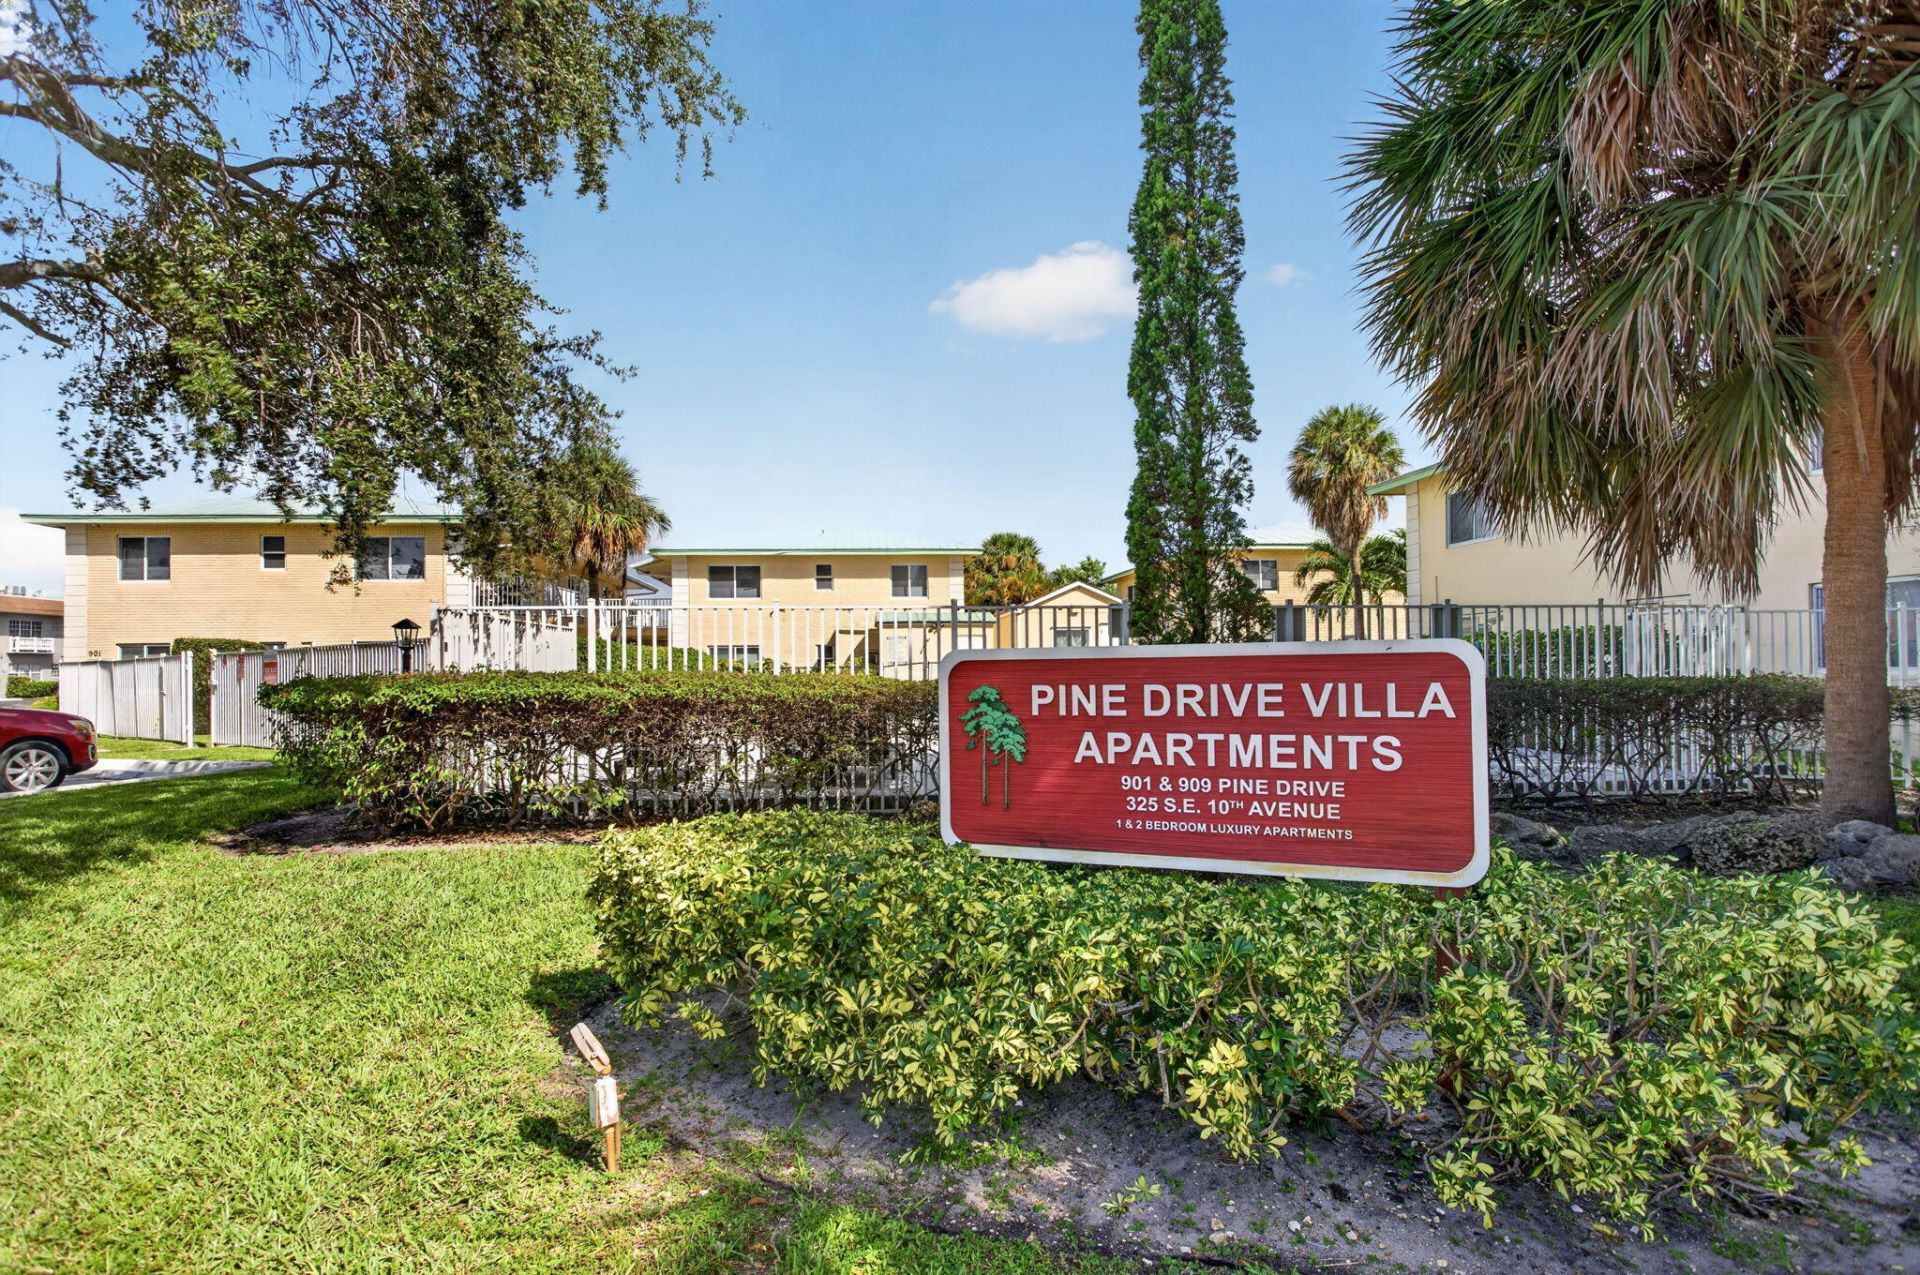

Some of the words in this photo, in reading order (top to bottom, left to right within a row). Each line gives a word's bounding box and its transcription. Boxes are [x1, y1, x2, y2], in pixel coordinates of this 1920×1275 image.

[1031, 684, 1127, 717] PINE
[1143, 683, 1285, 718] DRIVE
[1300, 682, 1457, 718] VILLA
[1074, 731, 1403, 772] APARTMENTS
[1121, 775, 1151, 791] 901
[1159, 776, 1173, 792] &
[1178, 777, 1212, 793] 909
[1218, 778, 1269, 795] PINE
[1276, 779, 1346, 798] DRIVE
[1126, 796, 1159, 812] 325
[1164, 797, 1201, 814] S.E.
[1207, 799, 1244, 815] 10TH
[1248, 800, 1341, 820] AVENUE
[1116, 819, 1122, 828] 1
[1125, 819, 1133, 829] &
[1135, 820, 1143, 830] 2
[1145, 820, 1207, 833] BEDROOM
[1210, 823, 1261, 836] LUXURY
[1263, 826, 1353, 840] APARTMENTS
